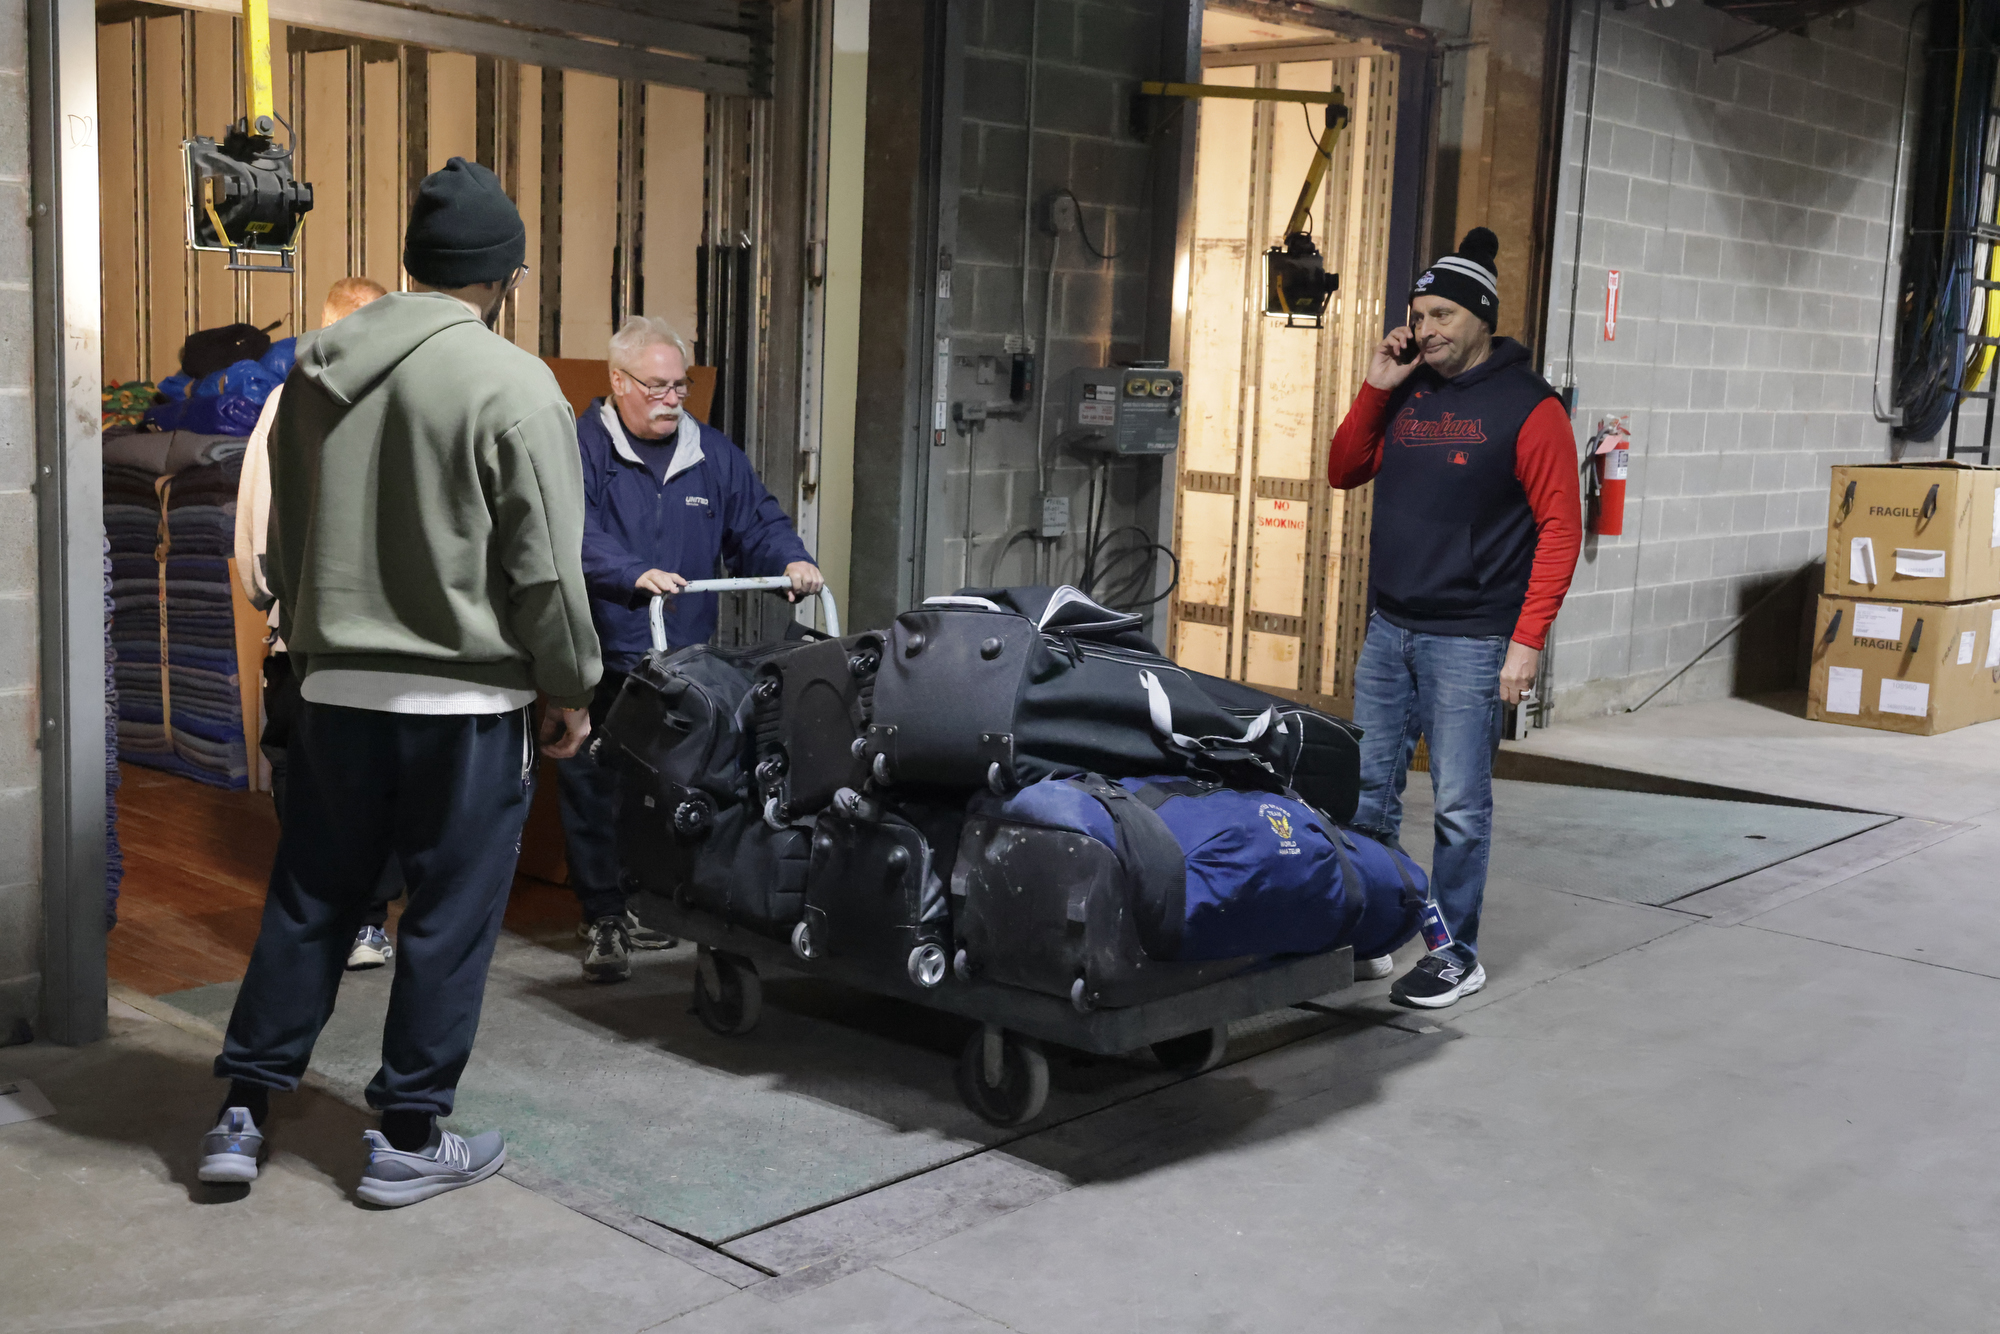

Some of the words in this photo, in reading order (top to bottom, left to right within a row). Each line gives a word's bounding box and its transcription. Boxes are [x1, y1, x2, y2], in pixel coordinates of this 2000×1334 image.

[1392, 408, 1487, 447] Guardians
[1274, 500, 1290, 511] NO
[1869, 506, 1919, 517] FRAGILE
[1258, 516, 1304, 530] SMOKING
[1853, 637, 1903, 651] FRAGILE
